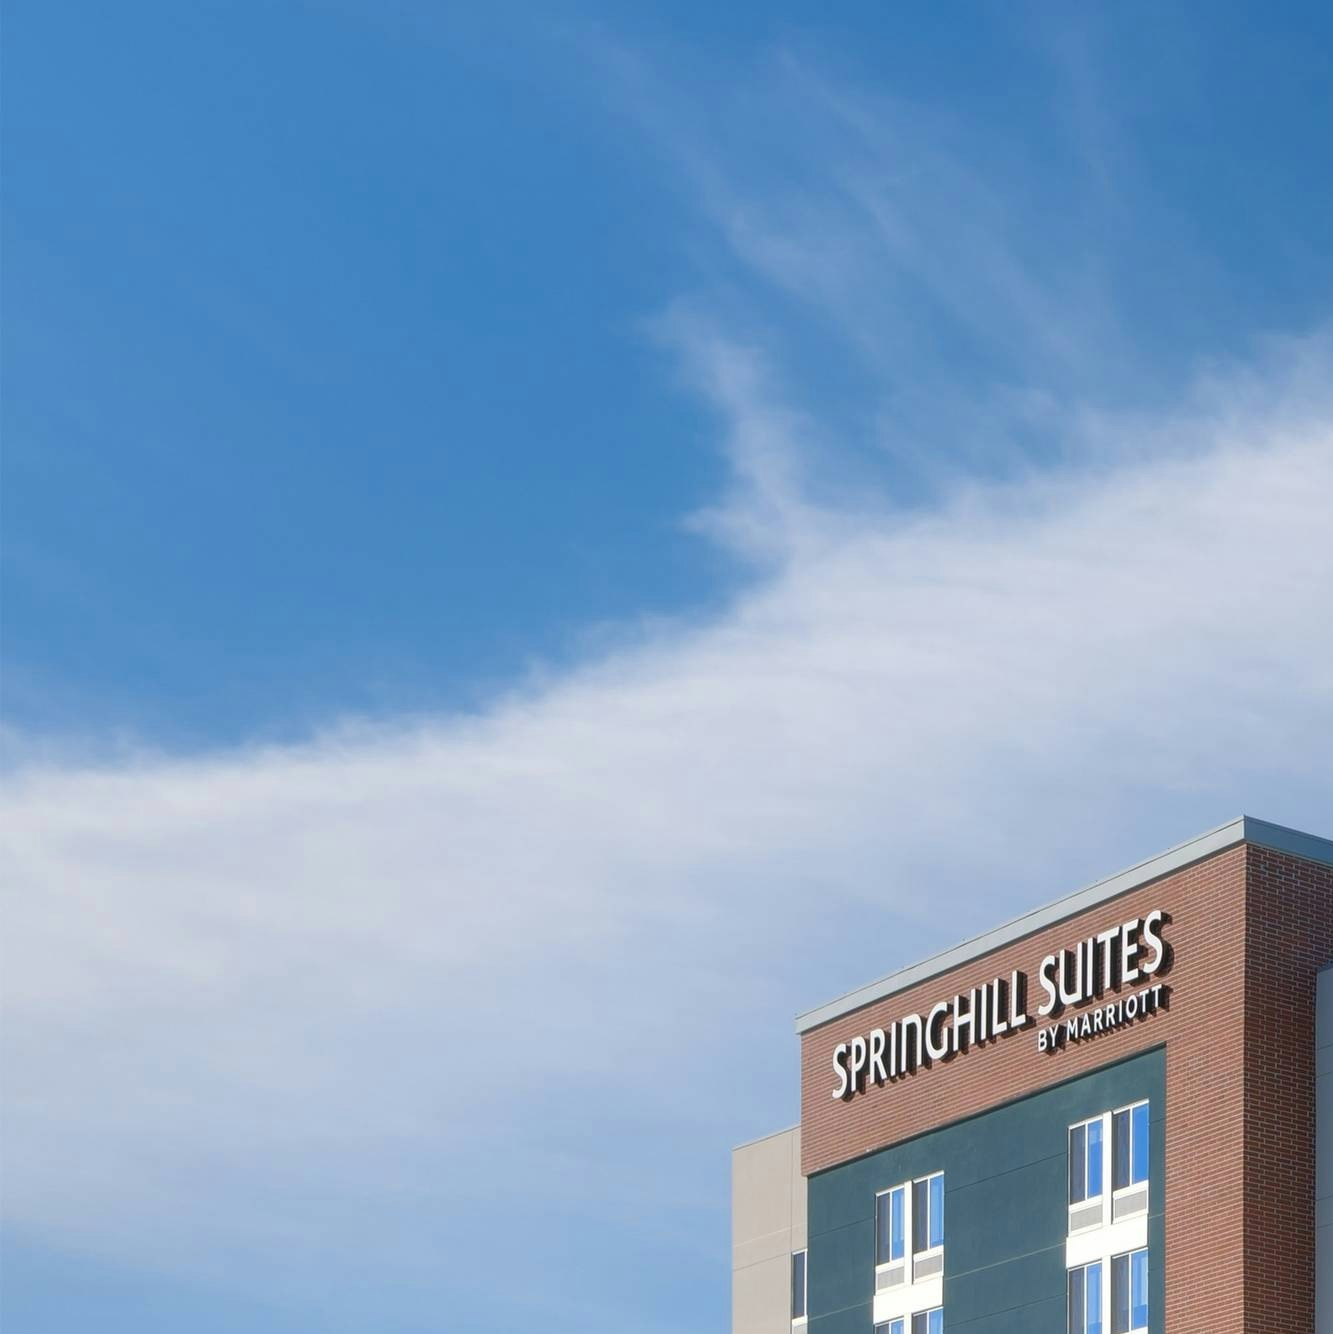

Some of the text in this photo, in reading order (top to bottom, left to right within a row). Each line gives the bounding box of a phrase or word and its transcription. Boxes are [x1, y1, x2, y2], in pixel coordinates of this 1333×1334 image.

[832, 910, 1163, 1099] SPRINGHILL SUITES
[1038, 983, 1163, 1052] BY MARRIOTT
